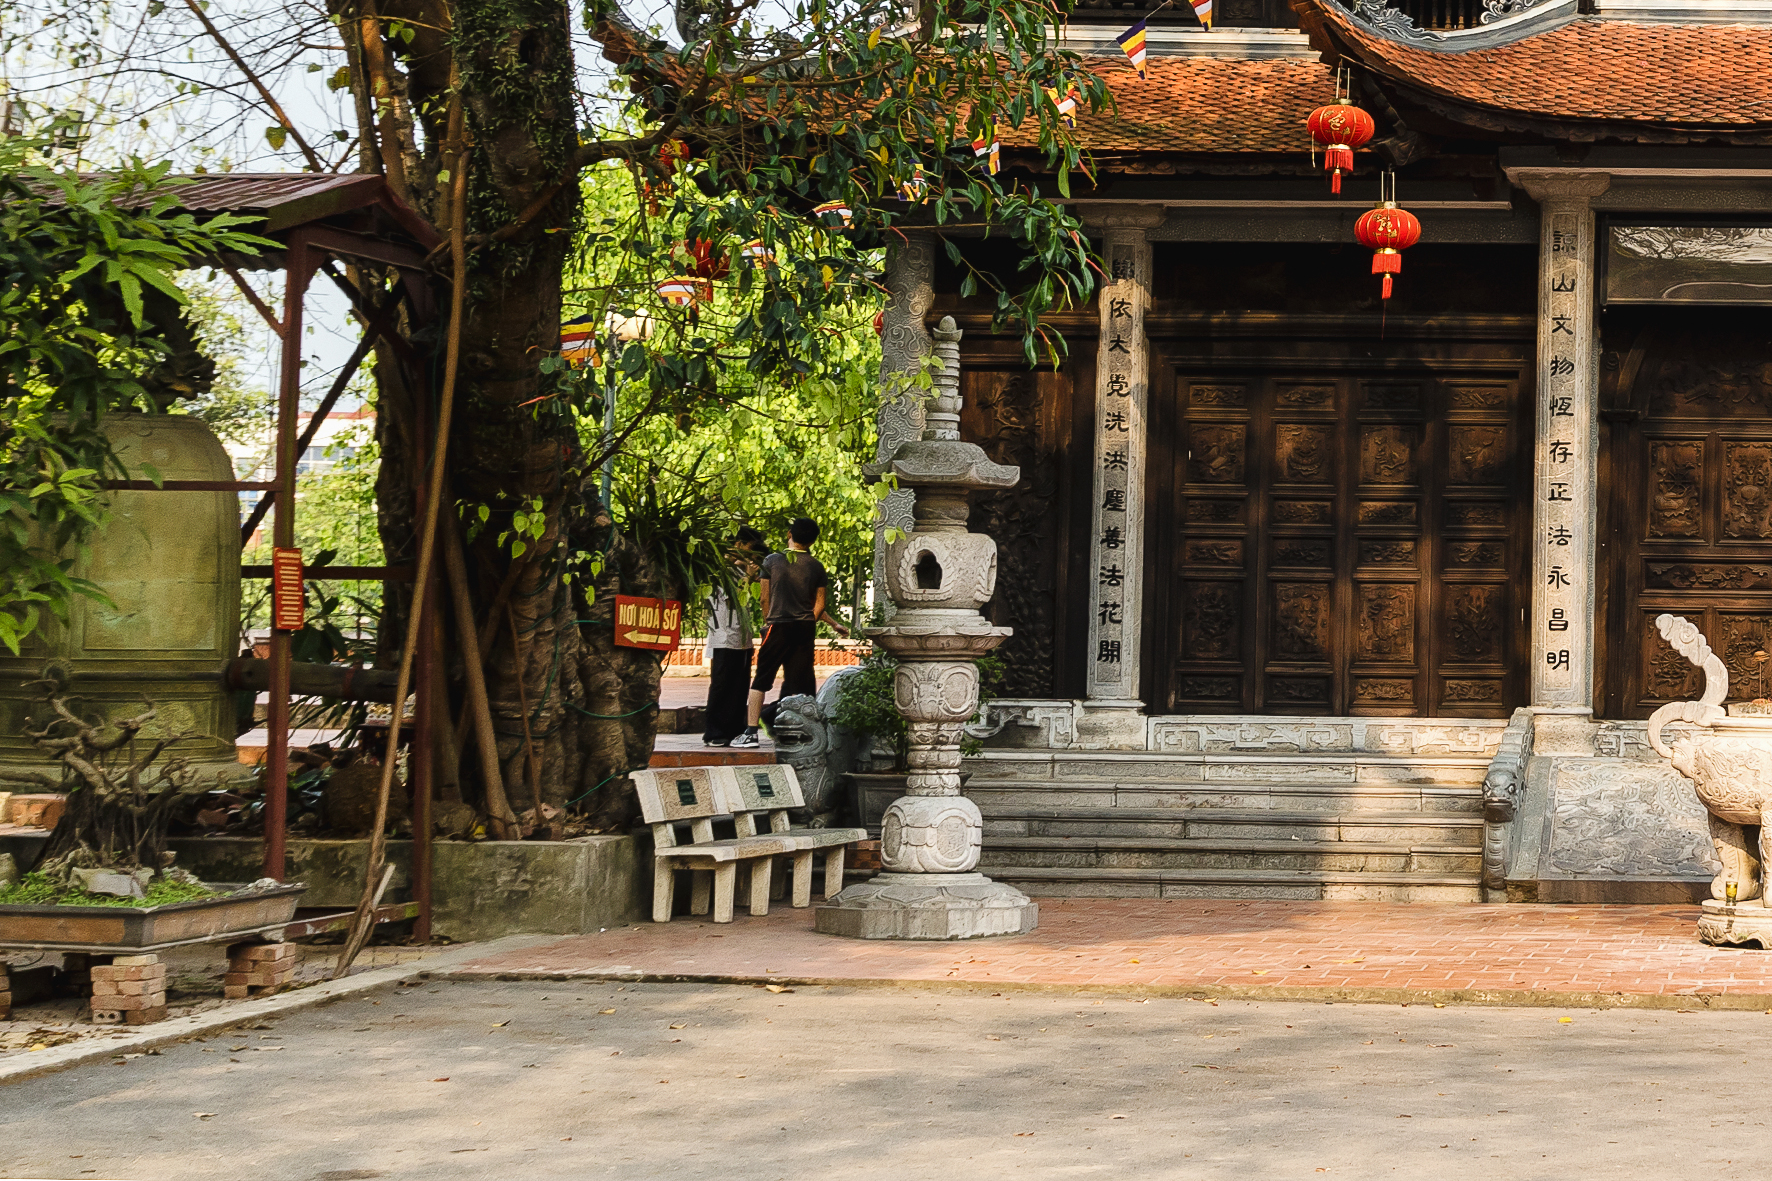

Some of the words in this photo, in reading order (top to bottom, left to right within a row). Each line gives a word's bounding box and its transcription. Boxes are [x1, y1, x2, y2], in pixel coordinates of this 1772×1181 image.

[618, 603, 638, 627] NƠI
[638, 604, 661, 629] HOÁ
[662, 604, 680, 631] SỚ
